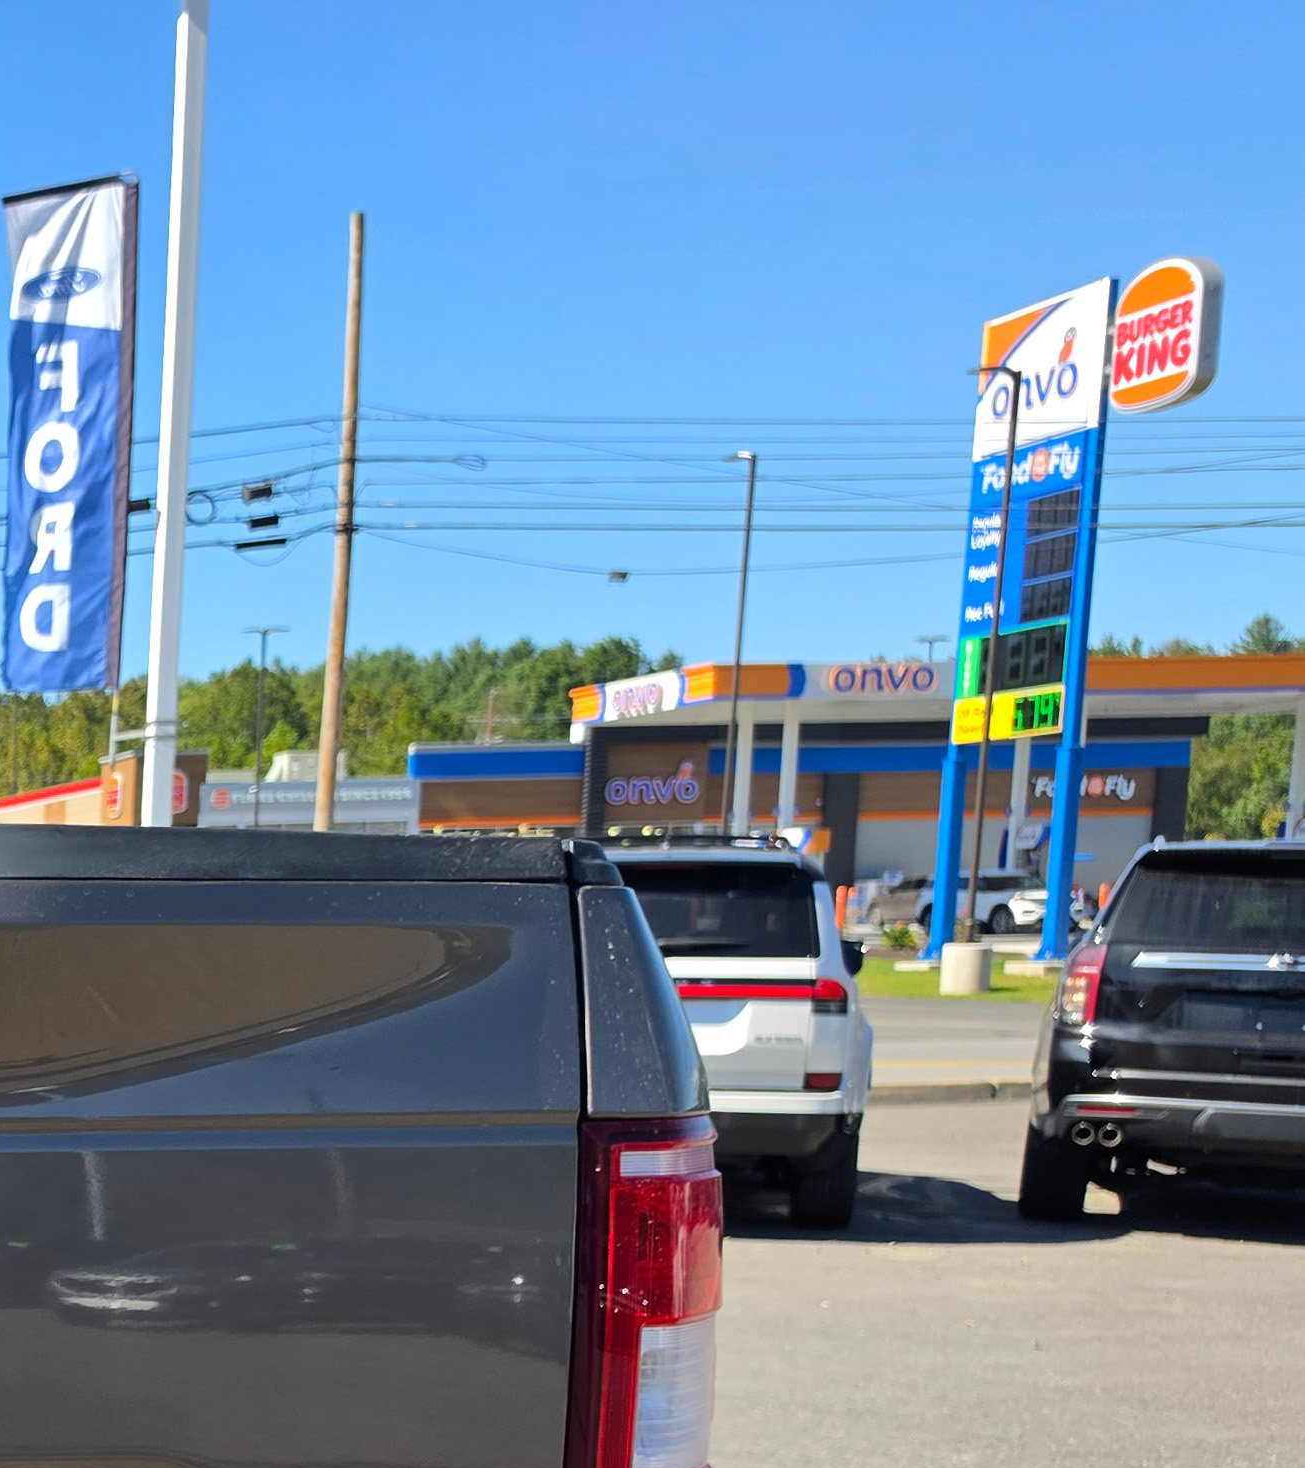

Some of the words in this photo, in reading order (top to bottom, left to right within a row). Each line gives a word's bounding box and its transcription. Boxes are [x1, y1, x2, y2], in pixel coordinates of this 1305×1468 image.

[1116, 300, 1193, 349] BURGER
[1114, 328, 1191, 386] KING
[833, 665, 935, 693] onvo
[605, 776, 699, 805] onvo
